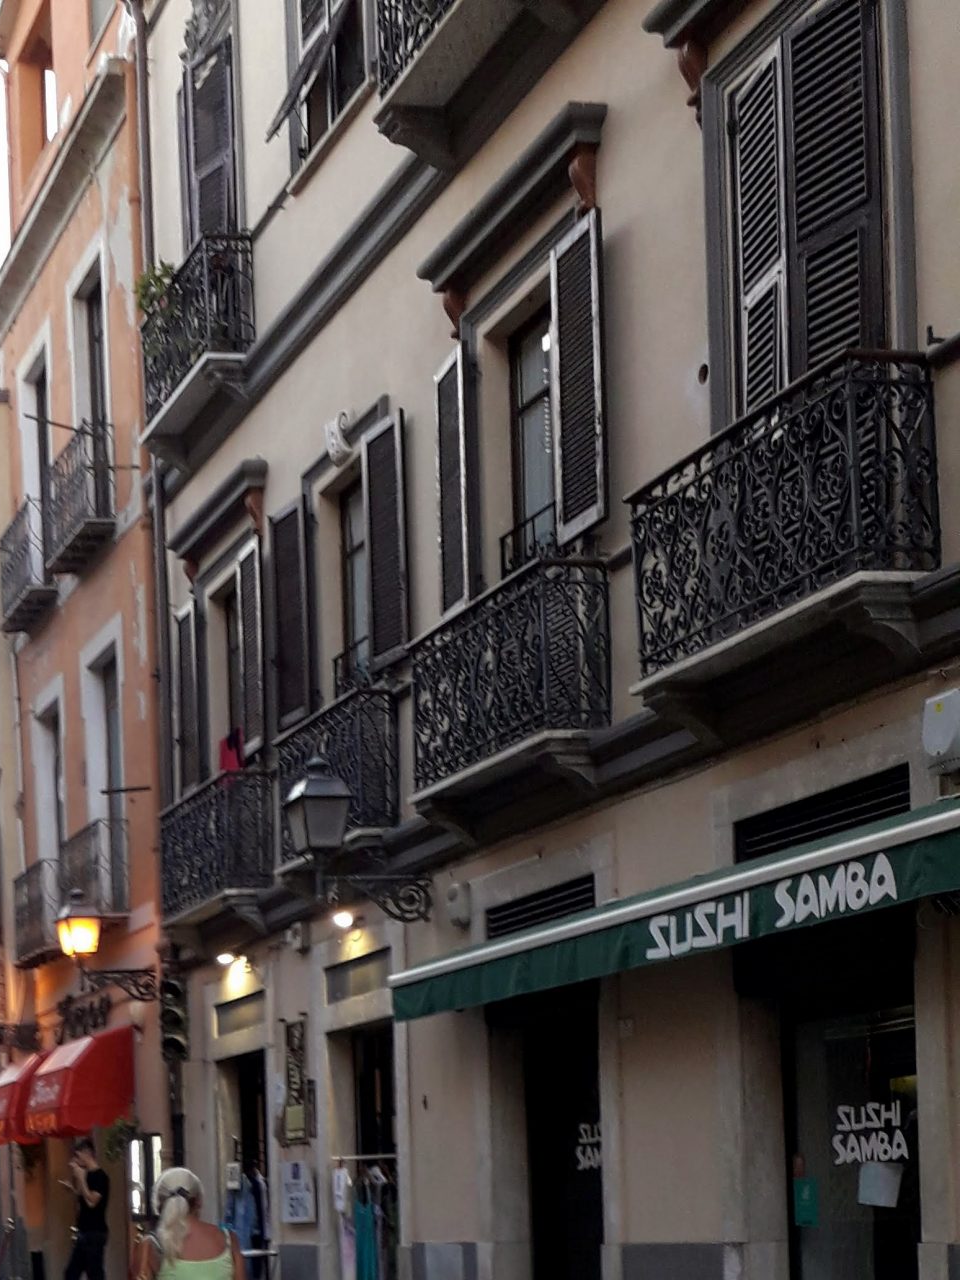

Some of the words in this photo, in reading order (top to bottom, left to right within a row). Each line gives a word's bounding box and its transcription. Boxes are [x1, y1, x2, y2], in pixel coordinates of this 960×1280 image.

[646, 890, 750, 960] SUSHI
[775, 852, 898, 928] SAMBA
[836, 1100, 901, 1131] SUSHI
[831, 1128, 910, 1165] SAMBA
